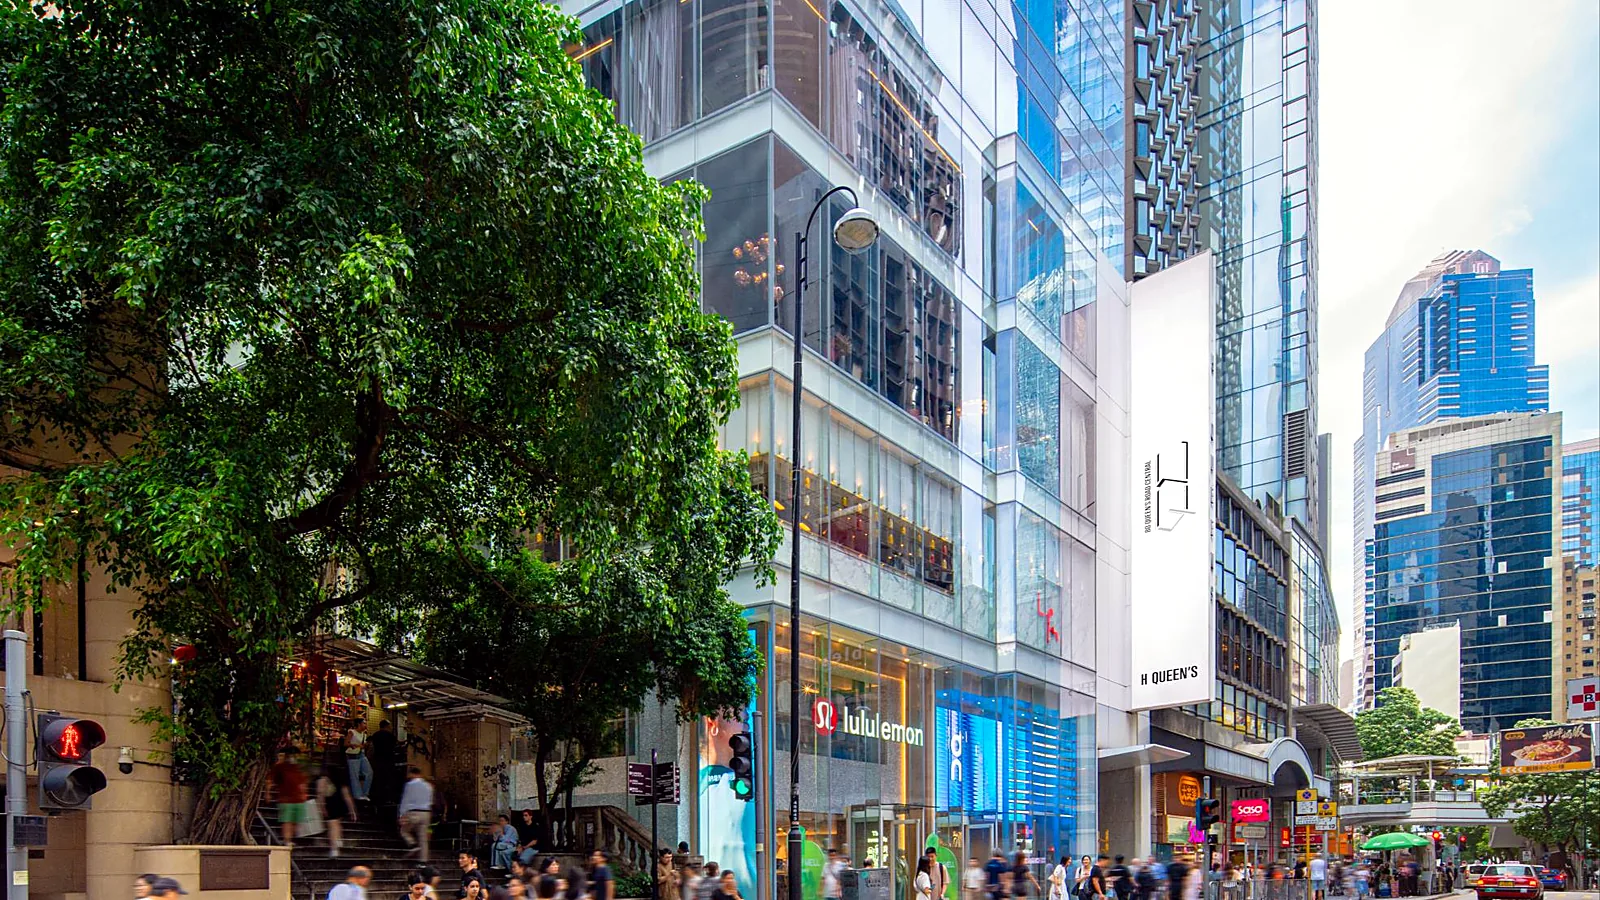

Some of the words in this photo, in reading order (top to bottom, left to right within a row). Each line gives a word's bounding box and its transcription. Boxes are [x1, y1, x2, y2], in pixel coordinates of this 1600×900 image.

[1141, 673, 1148, 686] H
[1152, 665, 1198, 685] QUEEN'S
[844, 706, 924, 747] lululemon
